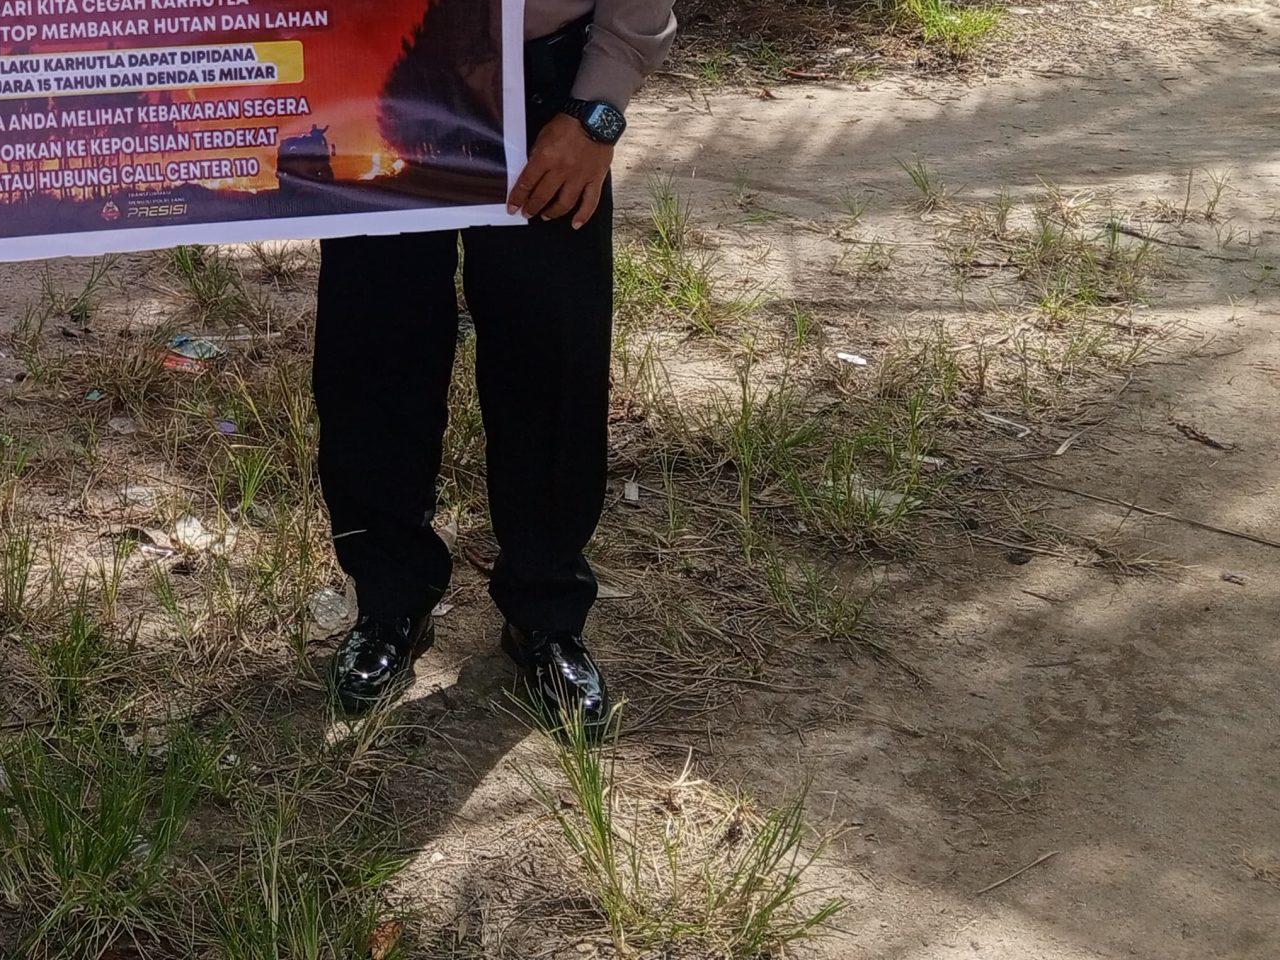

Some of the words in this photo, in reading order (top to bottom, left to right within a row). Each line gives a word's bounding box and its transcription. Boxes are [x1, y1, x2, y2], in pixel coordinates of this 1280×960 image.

[41, 18, 149, 40] MEMBAKAR
[154, 16, 216, 35] HUTAN
[221, 13, 260, 31] DAN
[265, 10, 328, 29] LAHAN
[44, 53, 125, 72] KARHUTLA
[128, 51, 177, 68] DAPAT
[181, 47, 256, 65] DIPIDANA
[37, 78, 51, 92] 15
[54, 74, 106, 91] TAHUN
[111, 72, 143, 87] DAN
[146, 69, 199, 86] DENDA
[201, 68, 215, 82] 15
[220, 65, 275, 82] MILYAR
[9, 112, 57, 131] ANDA
[61, 107, 134, 128] MELIHAT
[138, 101, 239, 123] KEBAKARAN
[244, 97, 310, 117] SEGERA
[66, 139, 87, 157] KE
[91, 134, 189, 155] KEPOLISIAN
[192, 128, 278, 149] TERDEKAT
[39, 167, 117, 189] HUBUNGI
[121, 163, 164, 182] CALL
[166, 159, 231, 180] CENTER
[235, 158, 259, 176] 110
[127, 203, 187, 218] PRESISI
